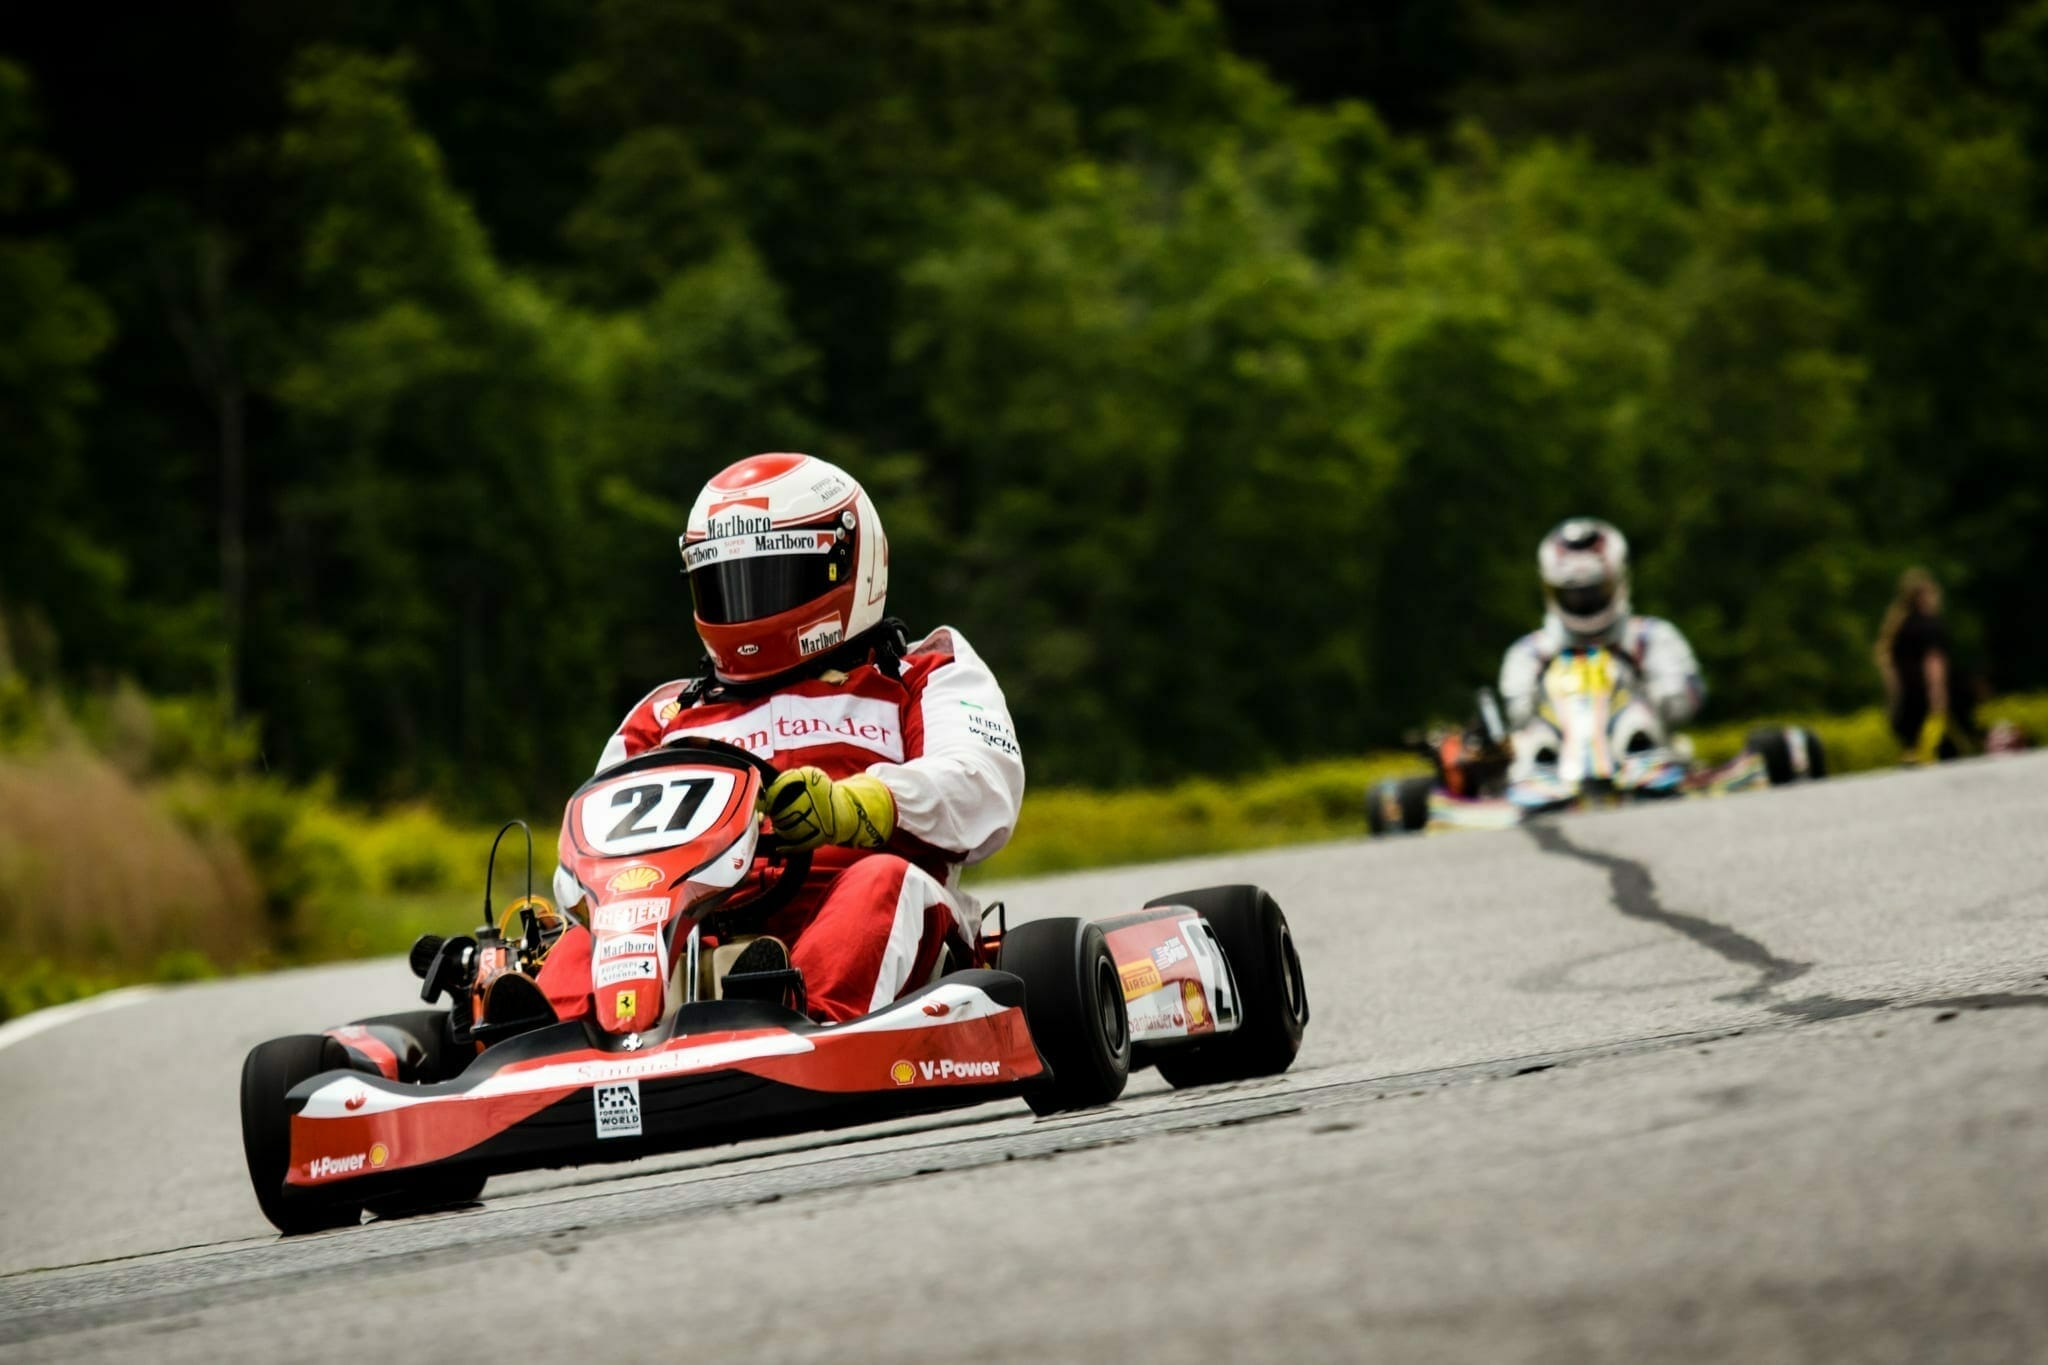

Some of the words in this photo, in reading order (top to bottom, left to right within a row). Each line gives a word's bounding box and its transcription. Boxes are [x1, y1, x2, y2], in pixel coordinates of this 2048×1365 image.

[708, 515, 771, 540] Marlboro
[755, 533, 815, 552] Marlboro
[801, 629, 843, 655] Marlboro
[606, 778, 715, 842] 27
[603, 941, 655, 957] Marlboro
[1121, 965, 1159, 993] PIRELLI
[919, 1060, 1001, 1081] V-Power
[600, 1107, 634, 1116] FORMULA
[601, 1115, 639, 1125] WORLD
[310, 1153, 366, 1179] V-Power
